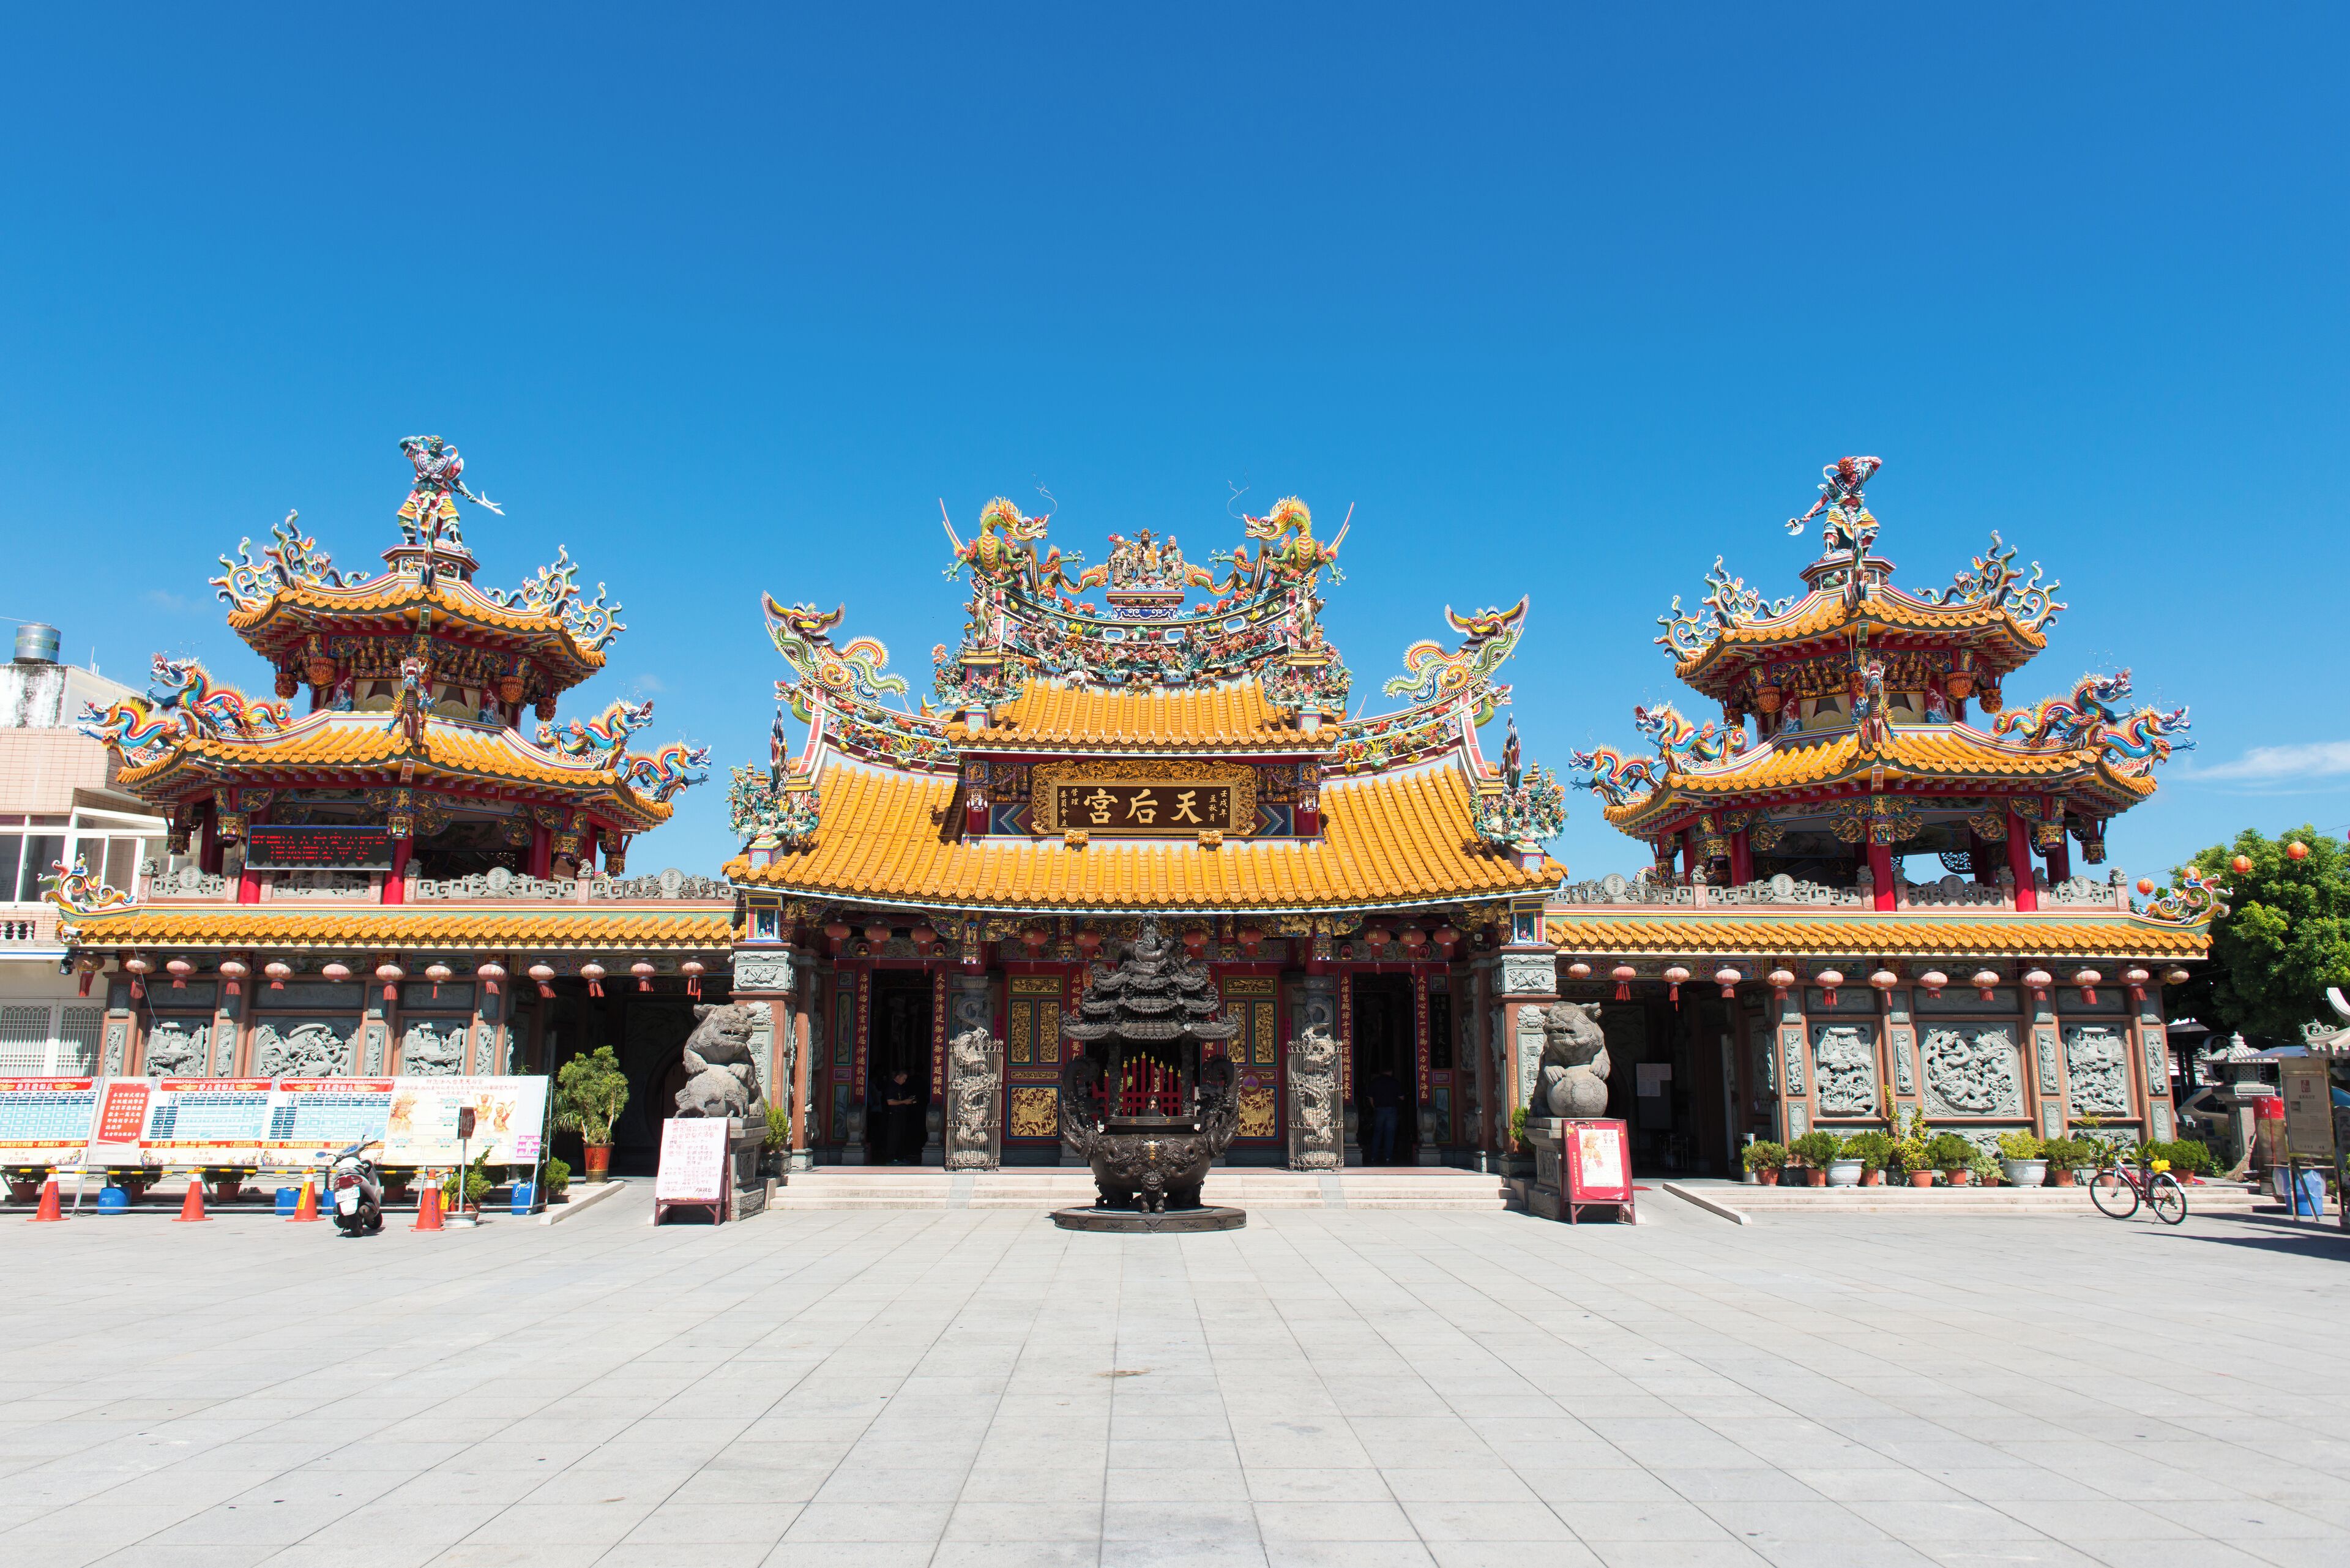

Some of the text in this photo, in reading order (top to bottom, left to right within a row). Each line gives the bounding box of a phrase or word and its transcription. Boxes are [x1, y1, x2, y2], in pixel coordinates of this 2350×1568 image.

[1059, 790, 1069, 827] 委員會立
[1071, 788, 1078, 805] 管理
[1083, 788, 1203, 824] 天后宮
[1209, 794, 1217, 822] 孟秋月
[1219, 790, 1228, 818] 壬戌年
